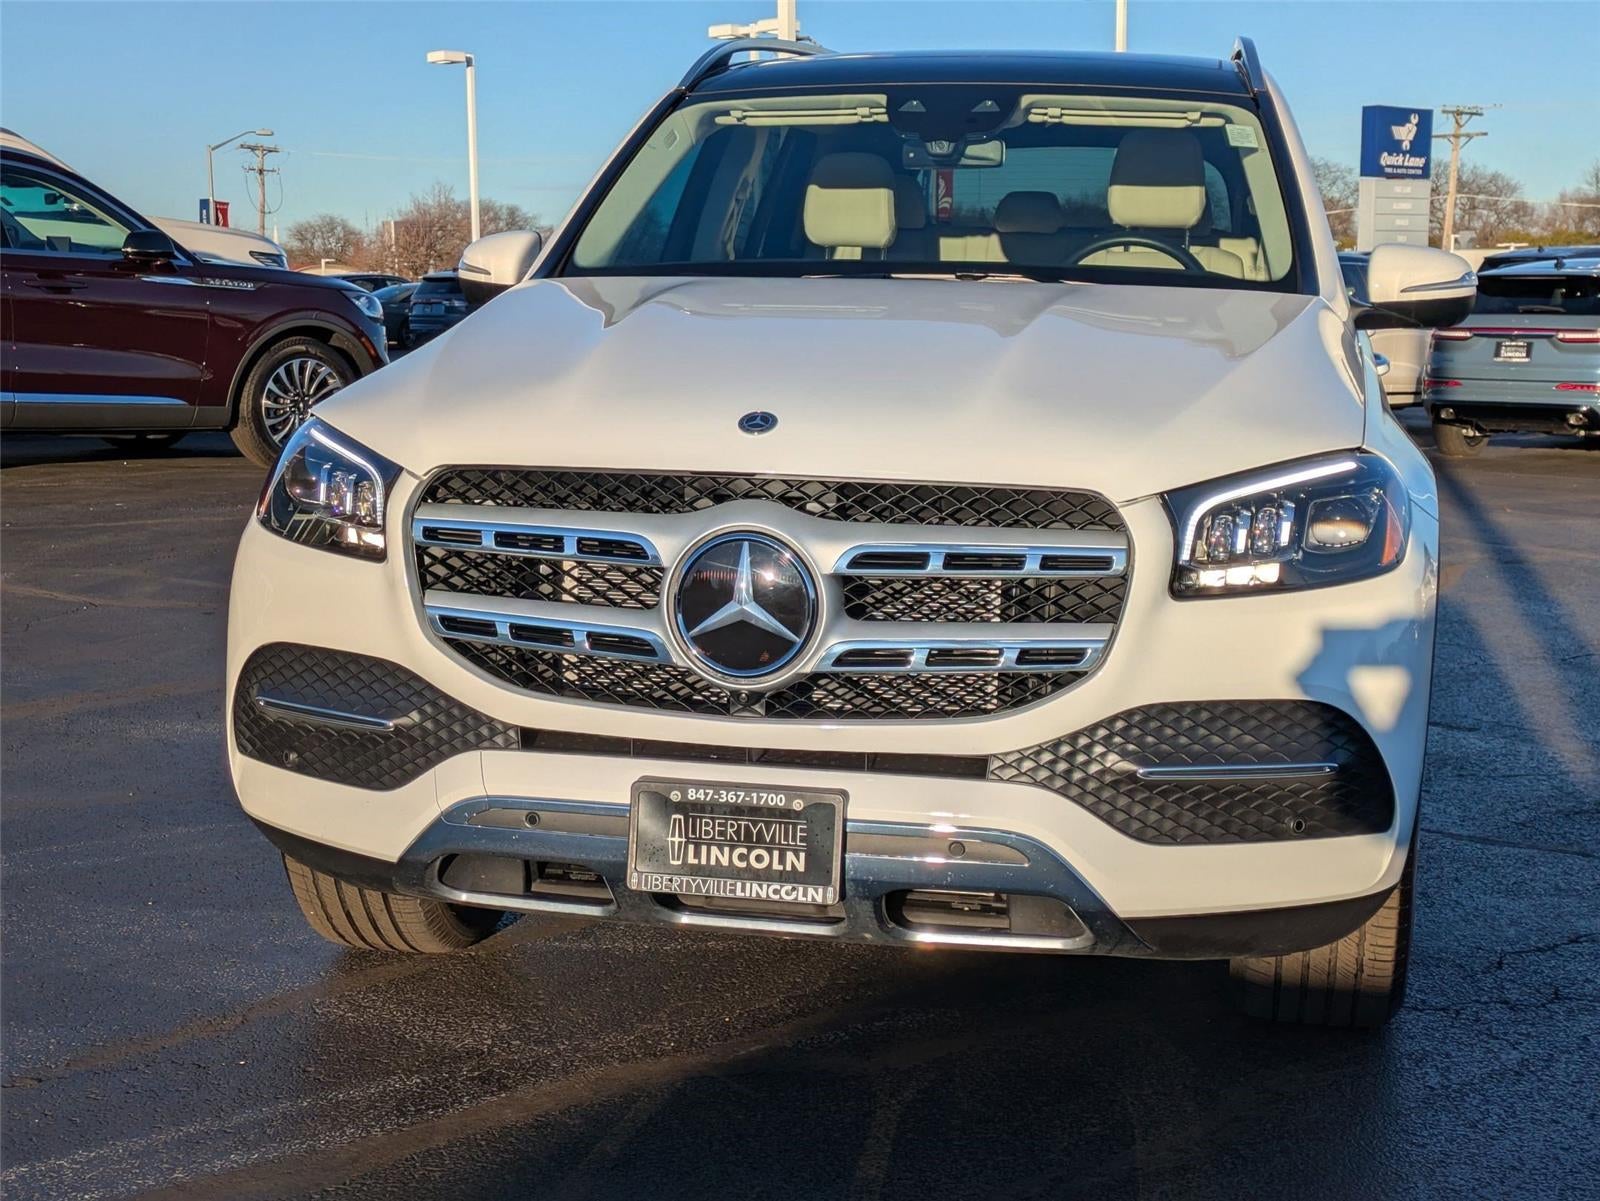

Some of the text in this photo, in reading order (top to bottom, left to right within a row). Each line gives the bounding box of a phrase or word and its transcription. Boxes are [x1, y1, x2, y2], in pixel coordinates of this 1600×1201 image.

[1380, 151, 1425, 167] Quick Lane
[687, 788, 786, 806] 847-367-1700
[688, 817, 808, 846] LIBERTYVILLE
[687, 844, 806, 872] LINCOLN
